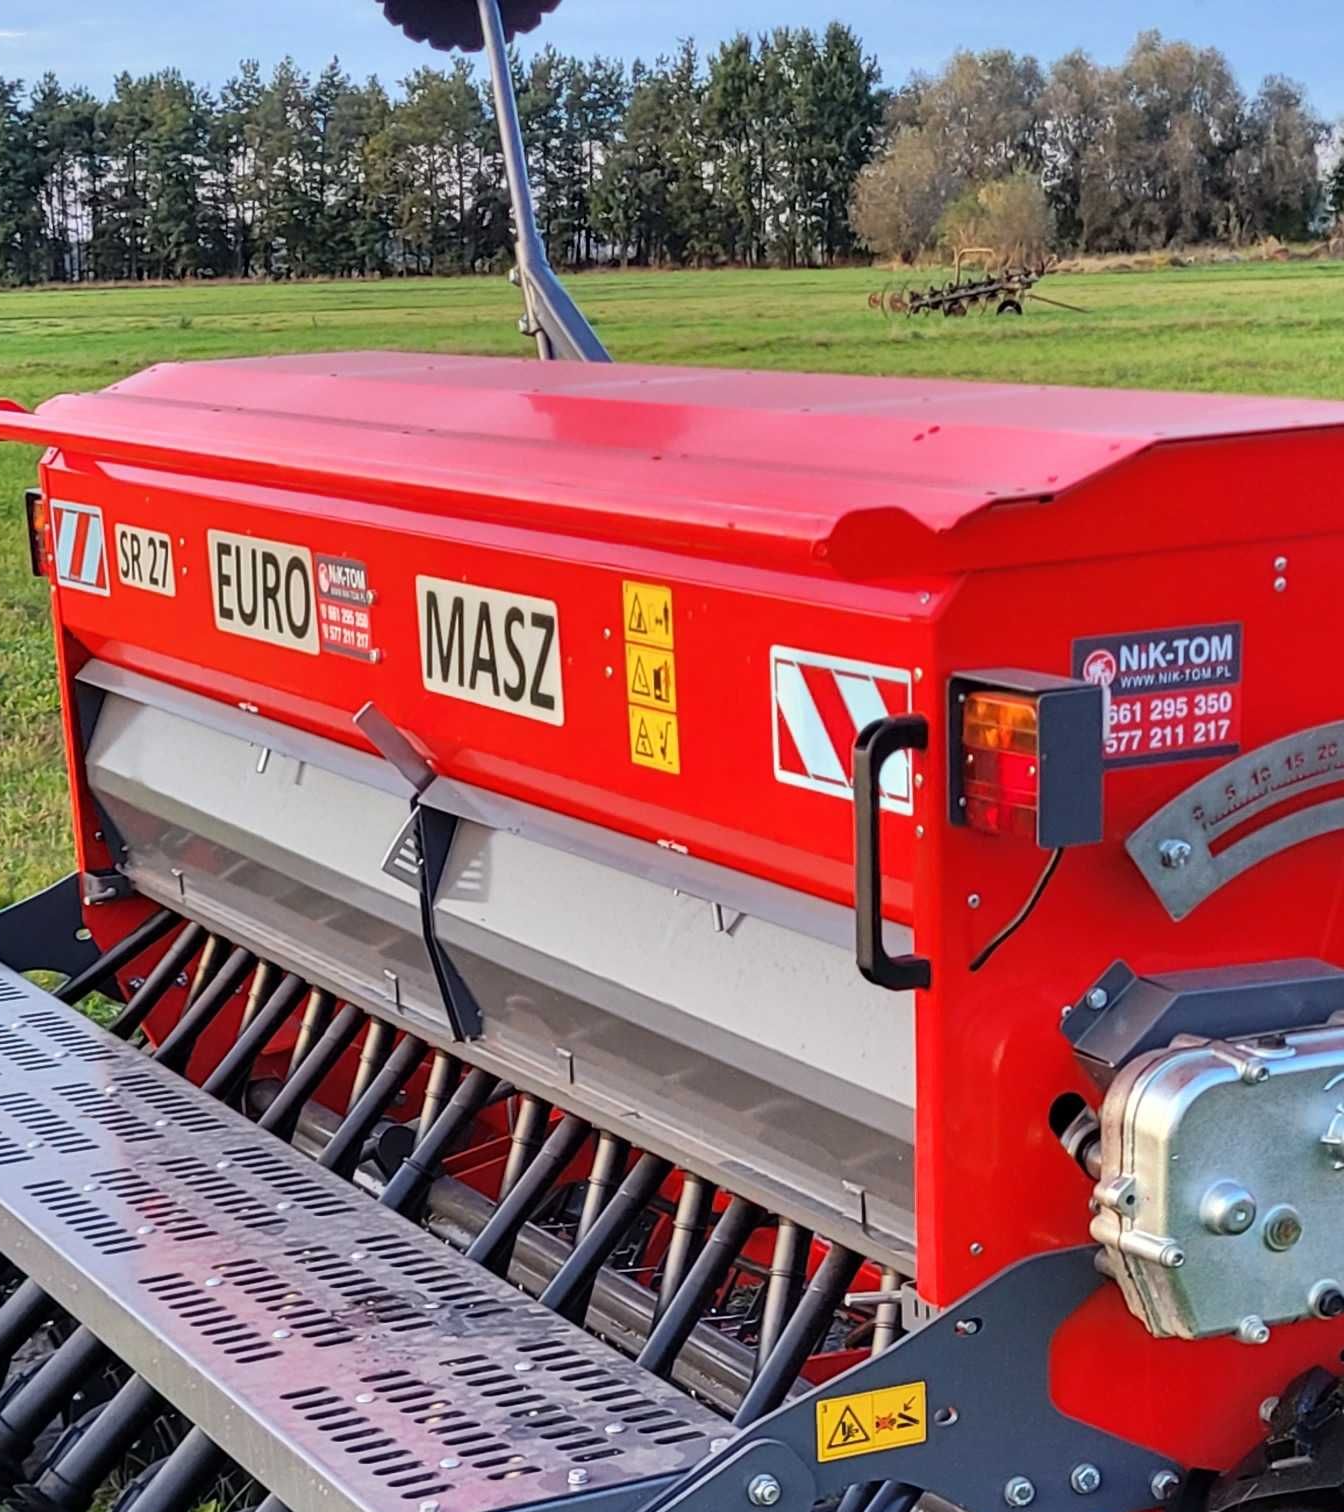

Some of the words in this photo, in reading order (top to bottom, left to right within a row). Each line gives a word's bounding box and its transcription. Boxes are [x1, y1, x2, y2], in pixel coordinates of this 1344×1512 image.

[120, 530, 141, 583] SR
[148, 536, 169, 589] 27
[216, 541, 312, 640] EURO
[426, 590, 555, 711] MASZ
[1150, 697, 1187, 720] 295
[1194, 691, 1232, 715] 350
[1105, 729, 1142, 753] 577
[1149, 725, 1184, 748] 211
[1194, 719, 1230, 743] 217
[1225, 784, 1236, 800] 5
[1251, 767, 1272, 785] 10
[1285, 753, 1304, 771] 15
[1318, 742, 1338, 761] 20
